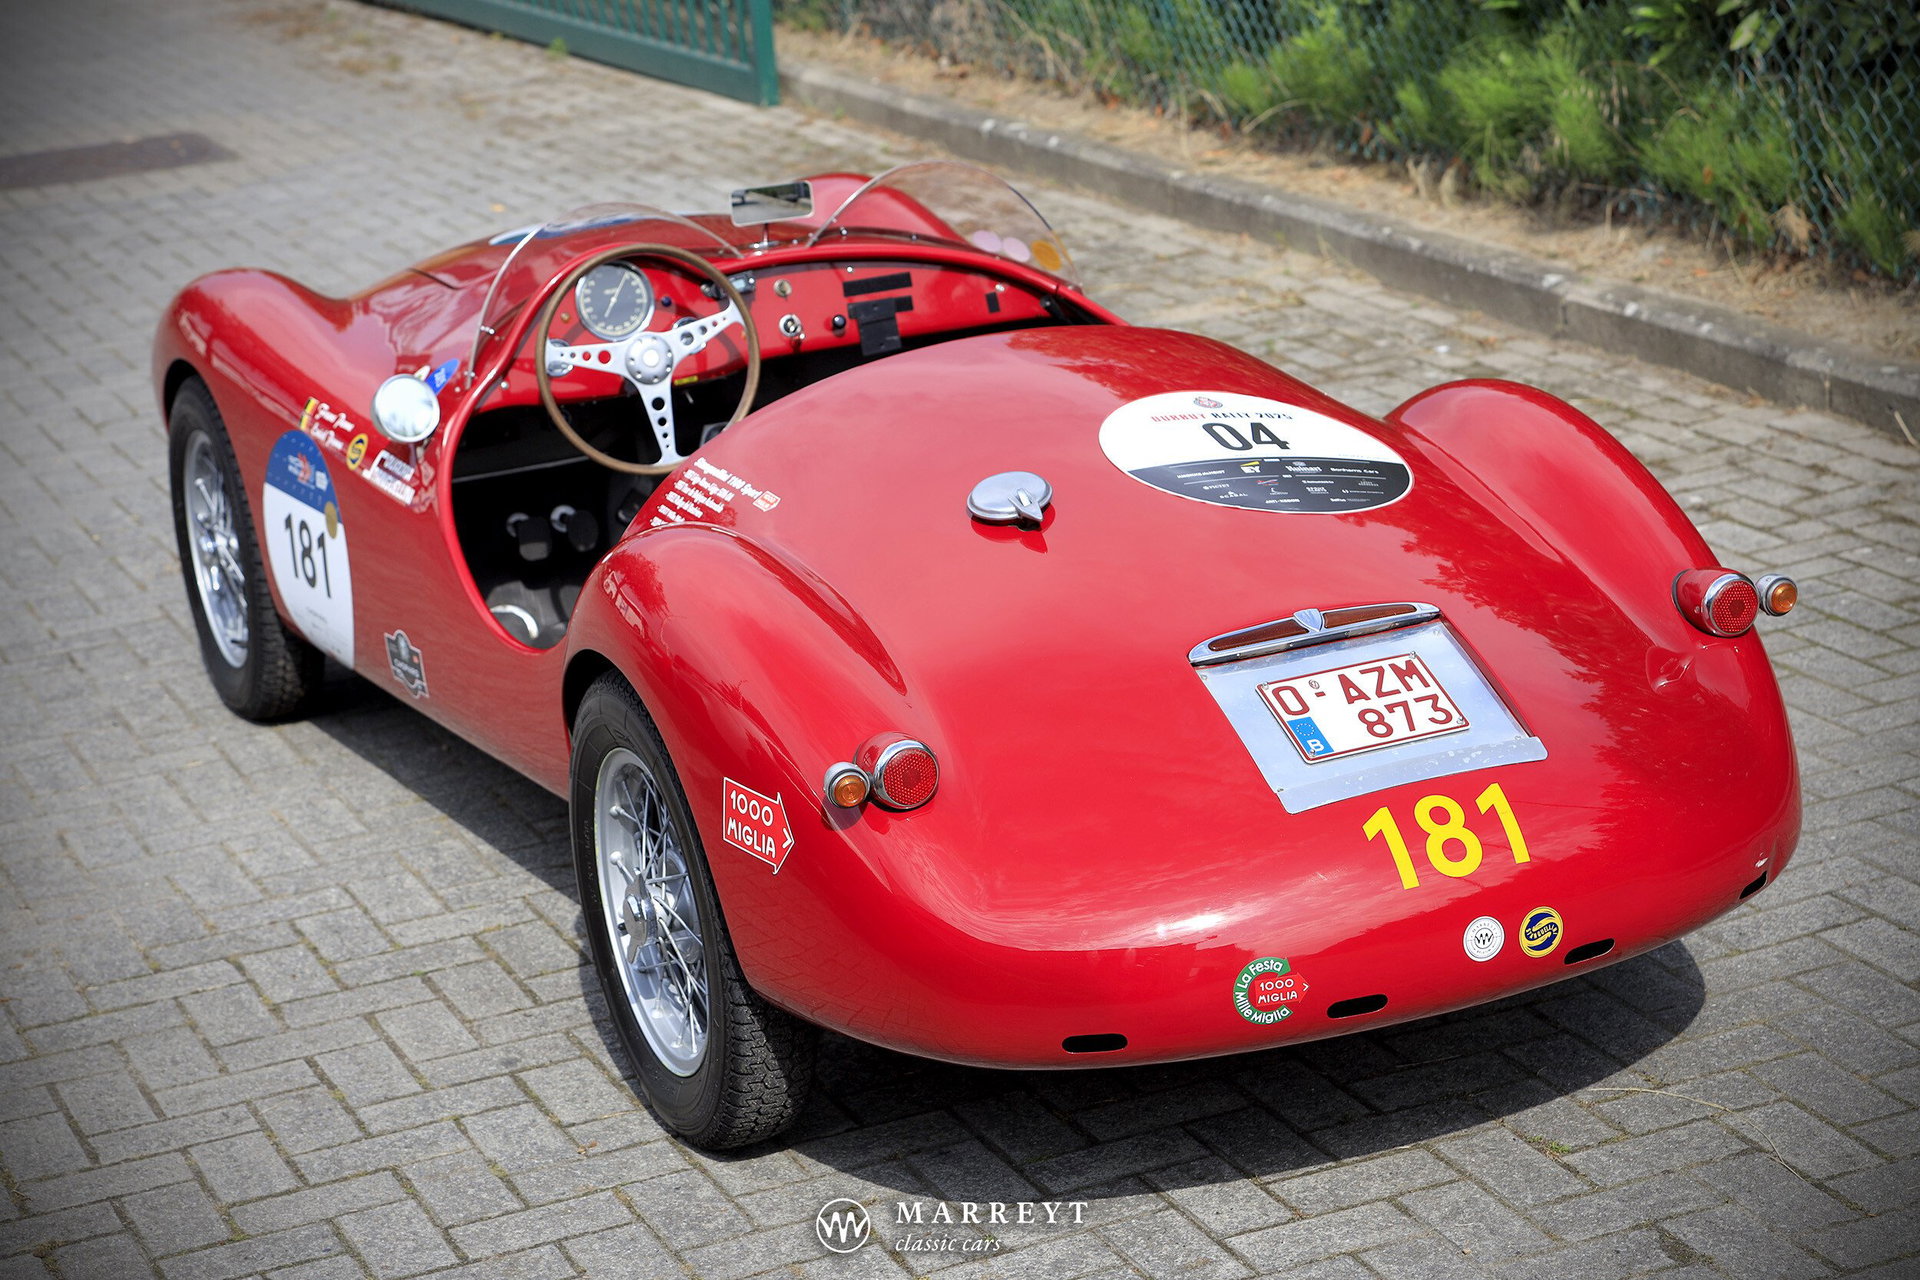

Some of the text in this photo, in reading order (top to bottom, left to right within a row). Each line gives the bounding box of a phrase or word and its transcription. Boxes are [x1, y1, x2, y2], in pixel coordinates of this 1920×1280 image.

[1202, 422, 1290, 451] 04
[284, 513, 332, 599] 181
[1357, 693, 1453, 738] 873
[1306, 739, 1324, 752] B
[730, 790, 774, 826] 1000
[727, 816, 776, 858] MIGLIA
[1362, 782, 1531, 890] 181
[1236, 960, 1283, 989] La Festa
[1260, 978, 1294, 992] 1000
[1235, 991, 1290, 1024] Mille Miglia
[1258, 990, 1298, 1004] MIGLIA
